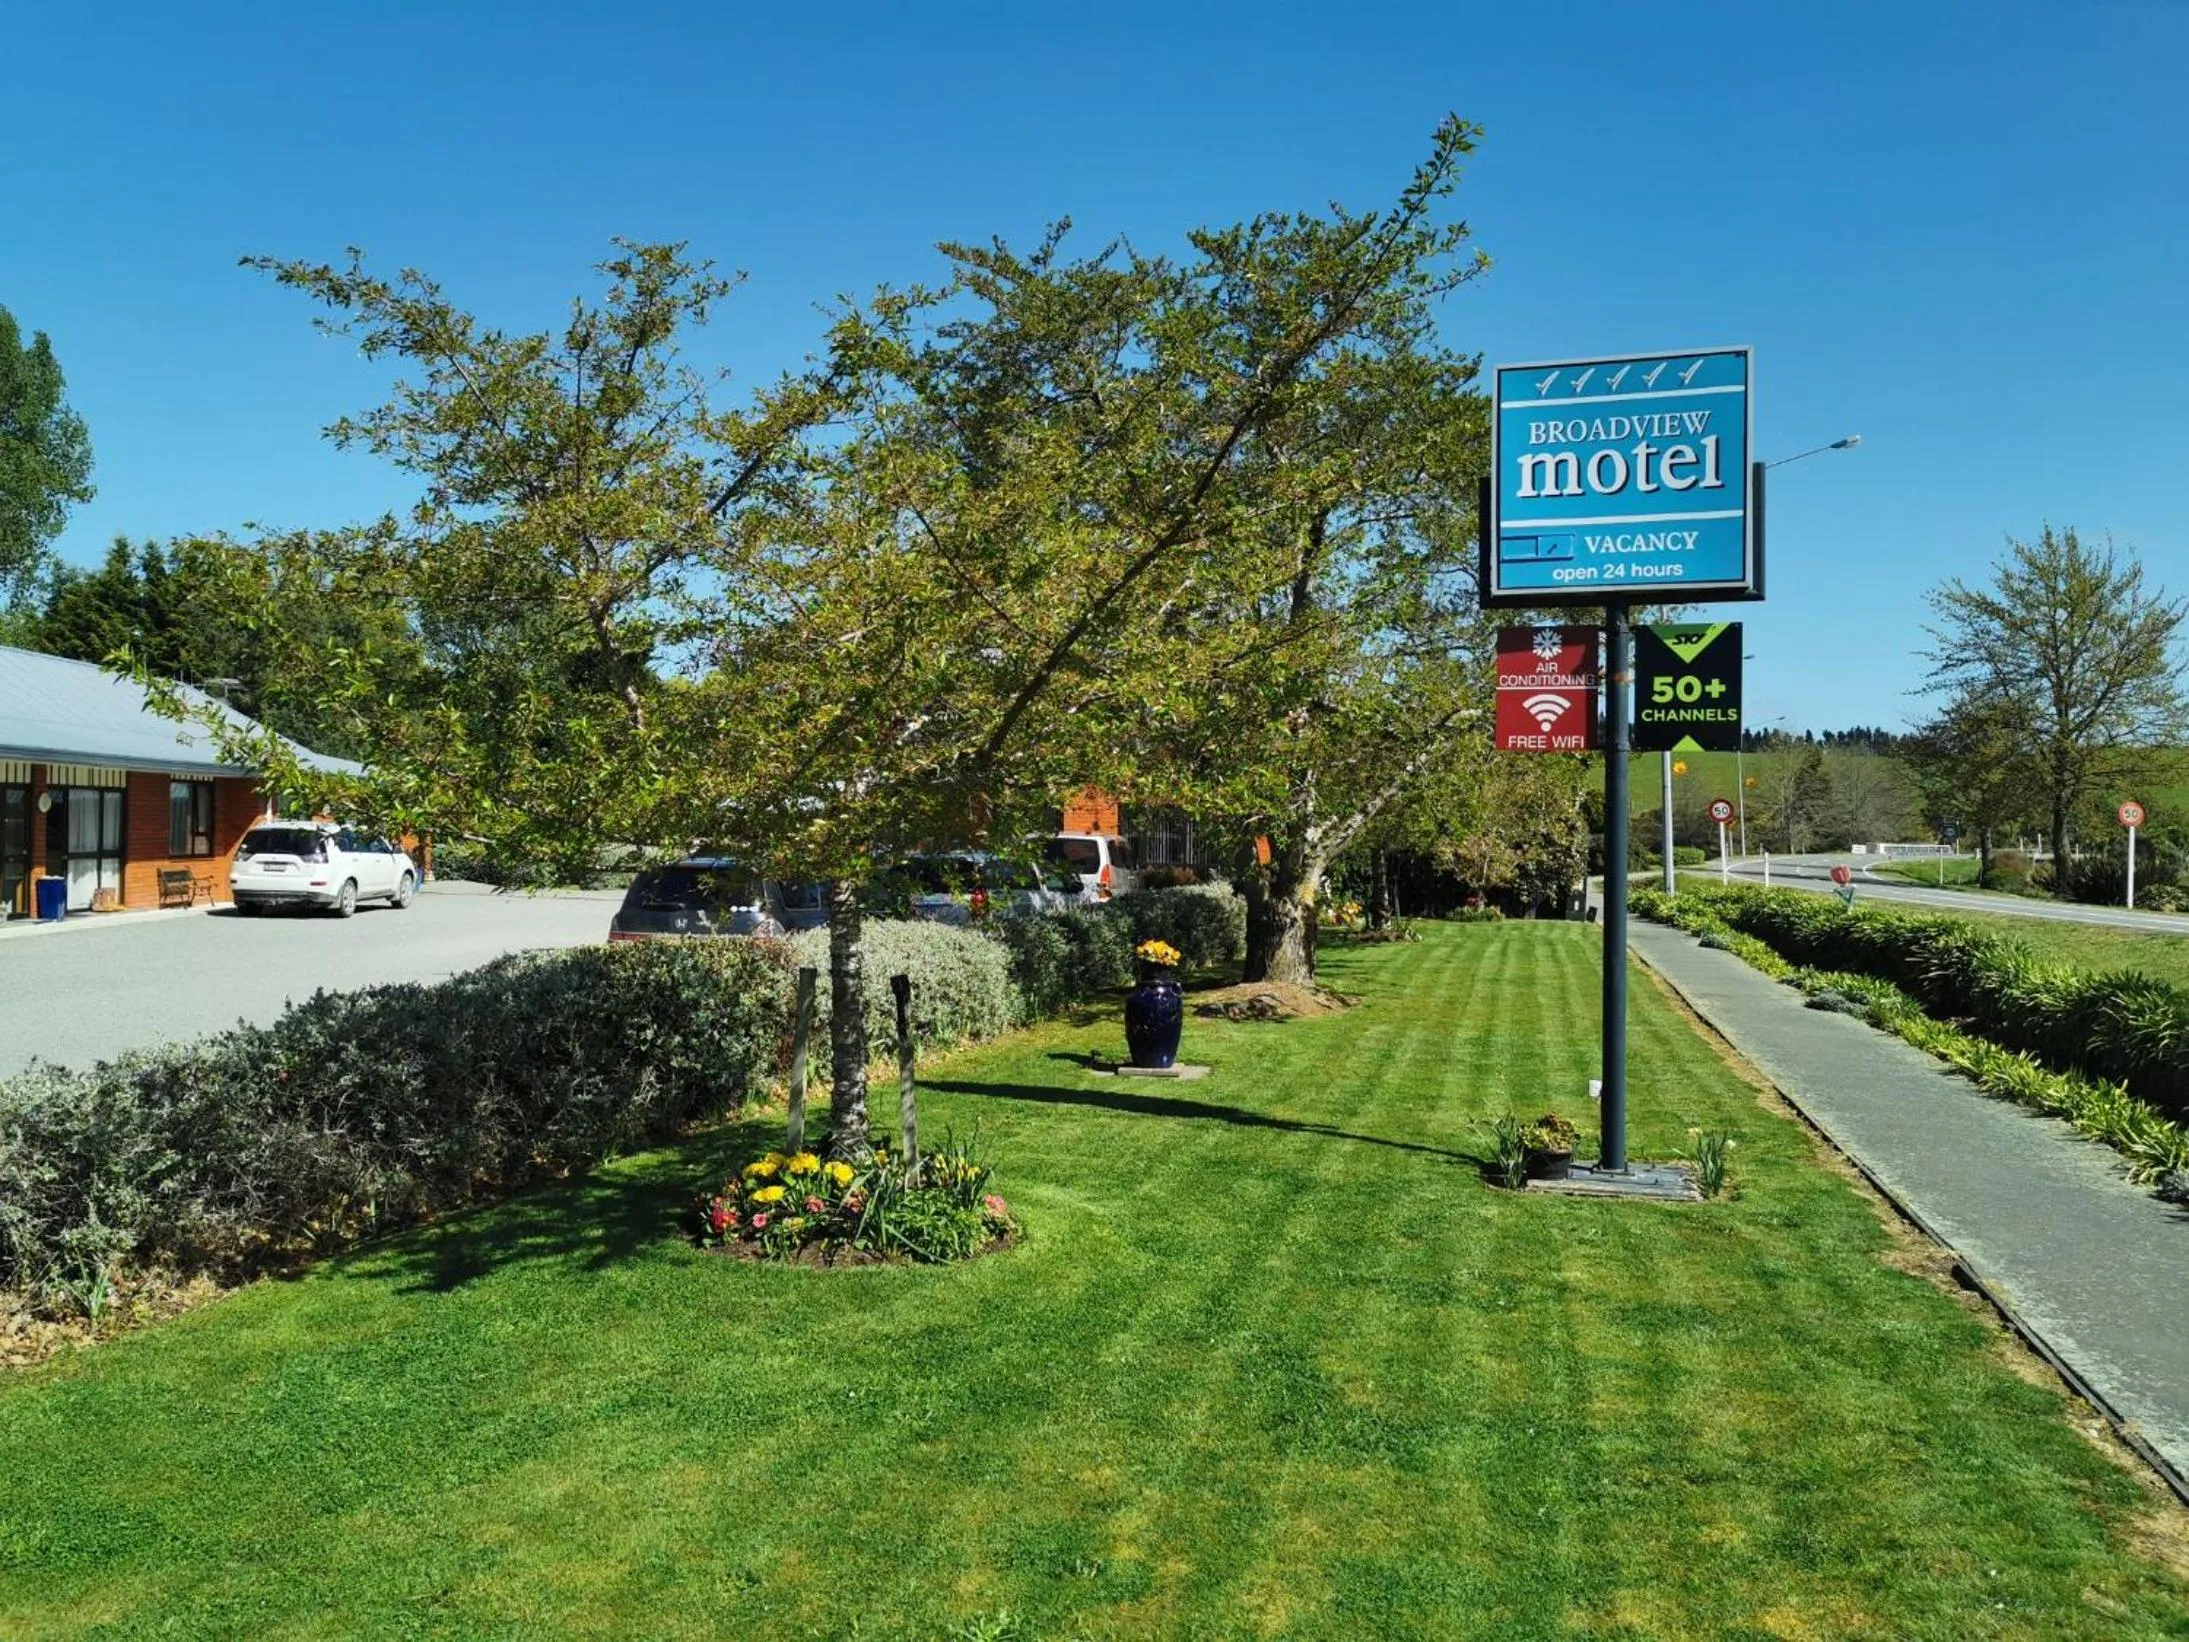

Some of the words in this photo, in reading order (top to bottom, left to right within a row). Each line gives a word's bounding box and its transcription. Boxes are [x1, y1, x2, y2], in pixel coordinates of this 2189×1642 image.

[1529, 411, 1711, 445] BROADVIEW
[1516, 434, 1724, 498] motel
[1584, 531, 1699, 553] VACANCY
[1552, 567, 1598, 583] open
[1603, 564, 1625, 579] 24
[1631, 562, 1683, 577] hours
[1536, 662, 1558, 673] AIR
[1500, 673, 1595, 687] CONDITIONING
[1651, 675, 1726, 704] 50+
[1641, 708, 1738, 722] CHANNELS
[1508, 735, 1547, 749] FREE
[1552, 735, 1585, 749] WIFI
[1714, 806, 1729, 816] 50
[2125, 809, 2138, 819] 50
